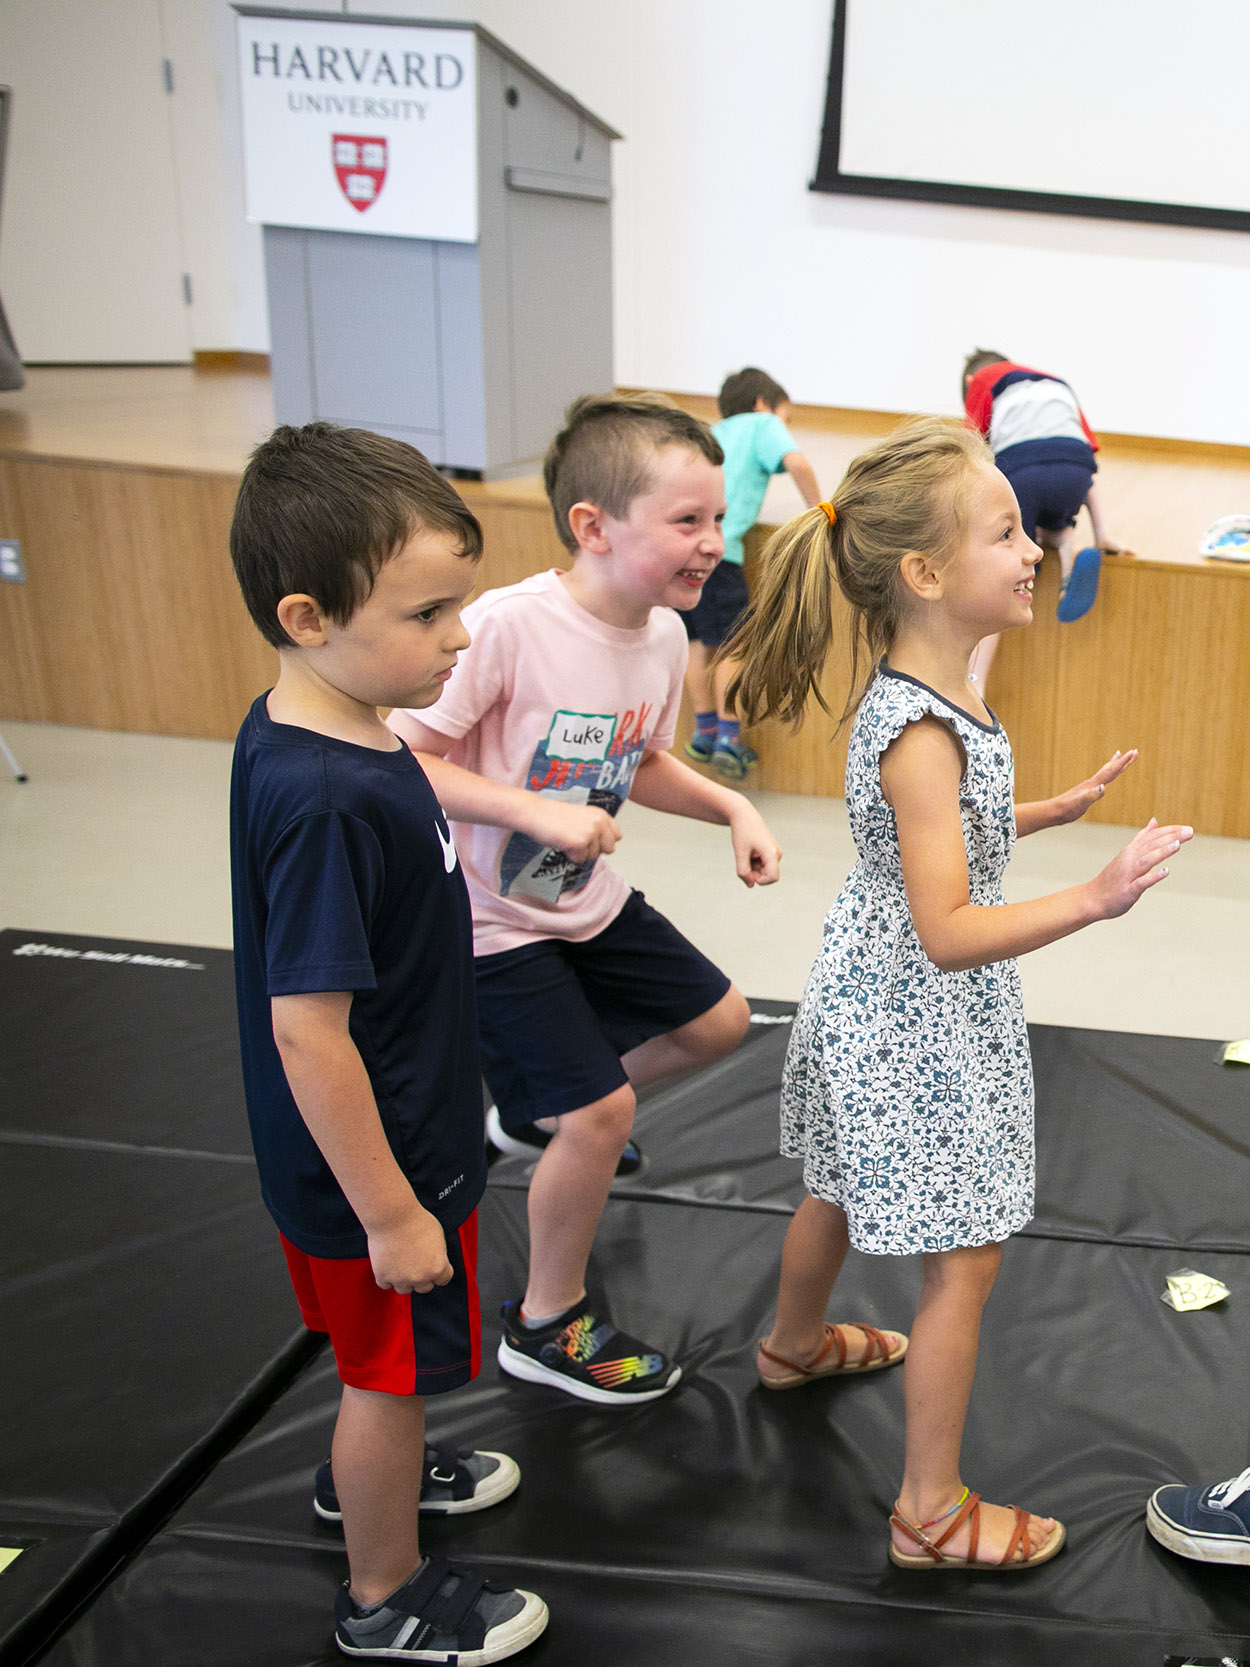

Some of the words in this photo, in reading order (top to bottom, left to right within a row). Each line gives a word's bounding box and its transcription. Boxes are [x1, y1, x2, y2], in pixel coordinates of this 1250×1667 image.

[251, 41, 464, 91] HARVARD
[287, 92, 429, 121] UNIVERSITY
[438, 1174, 464, 1200] DRI-FIT
